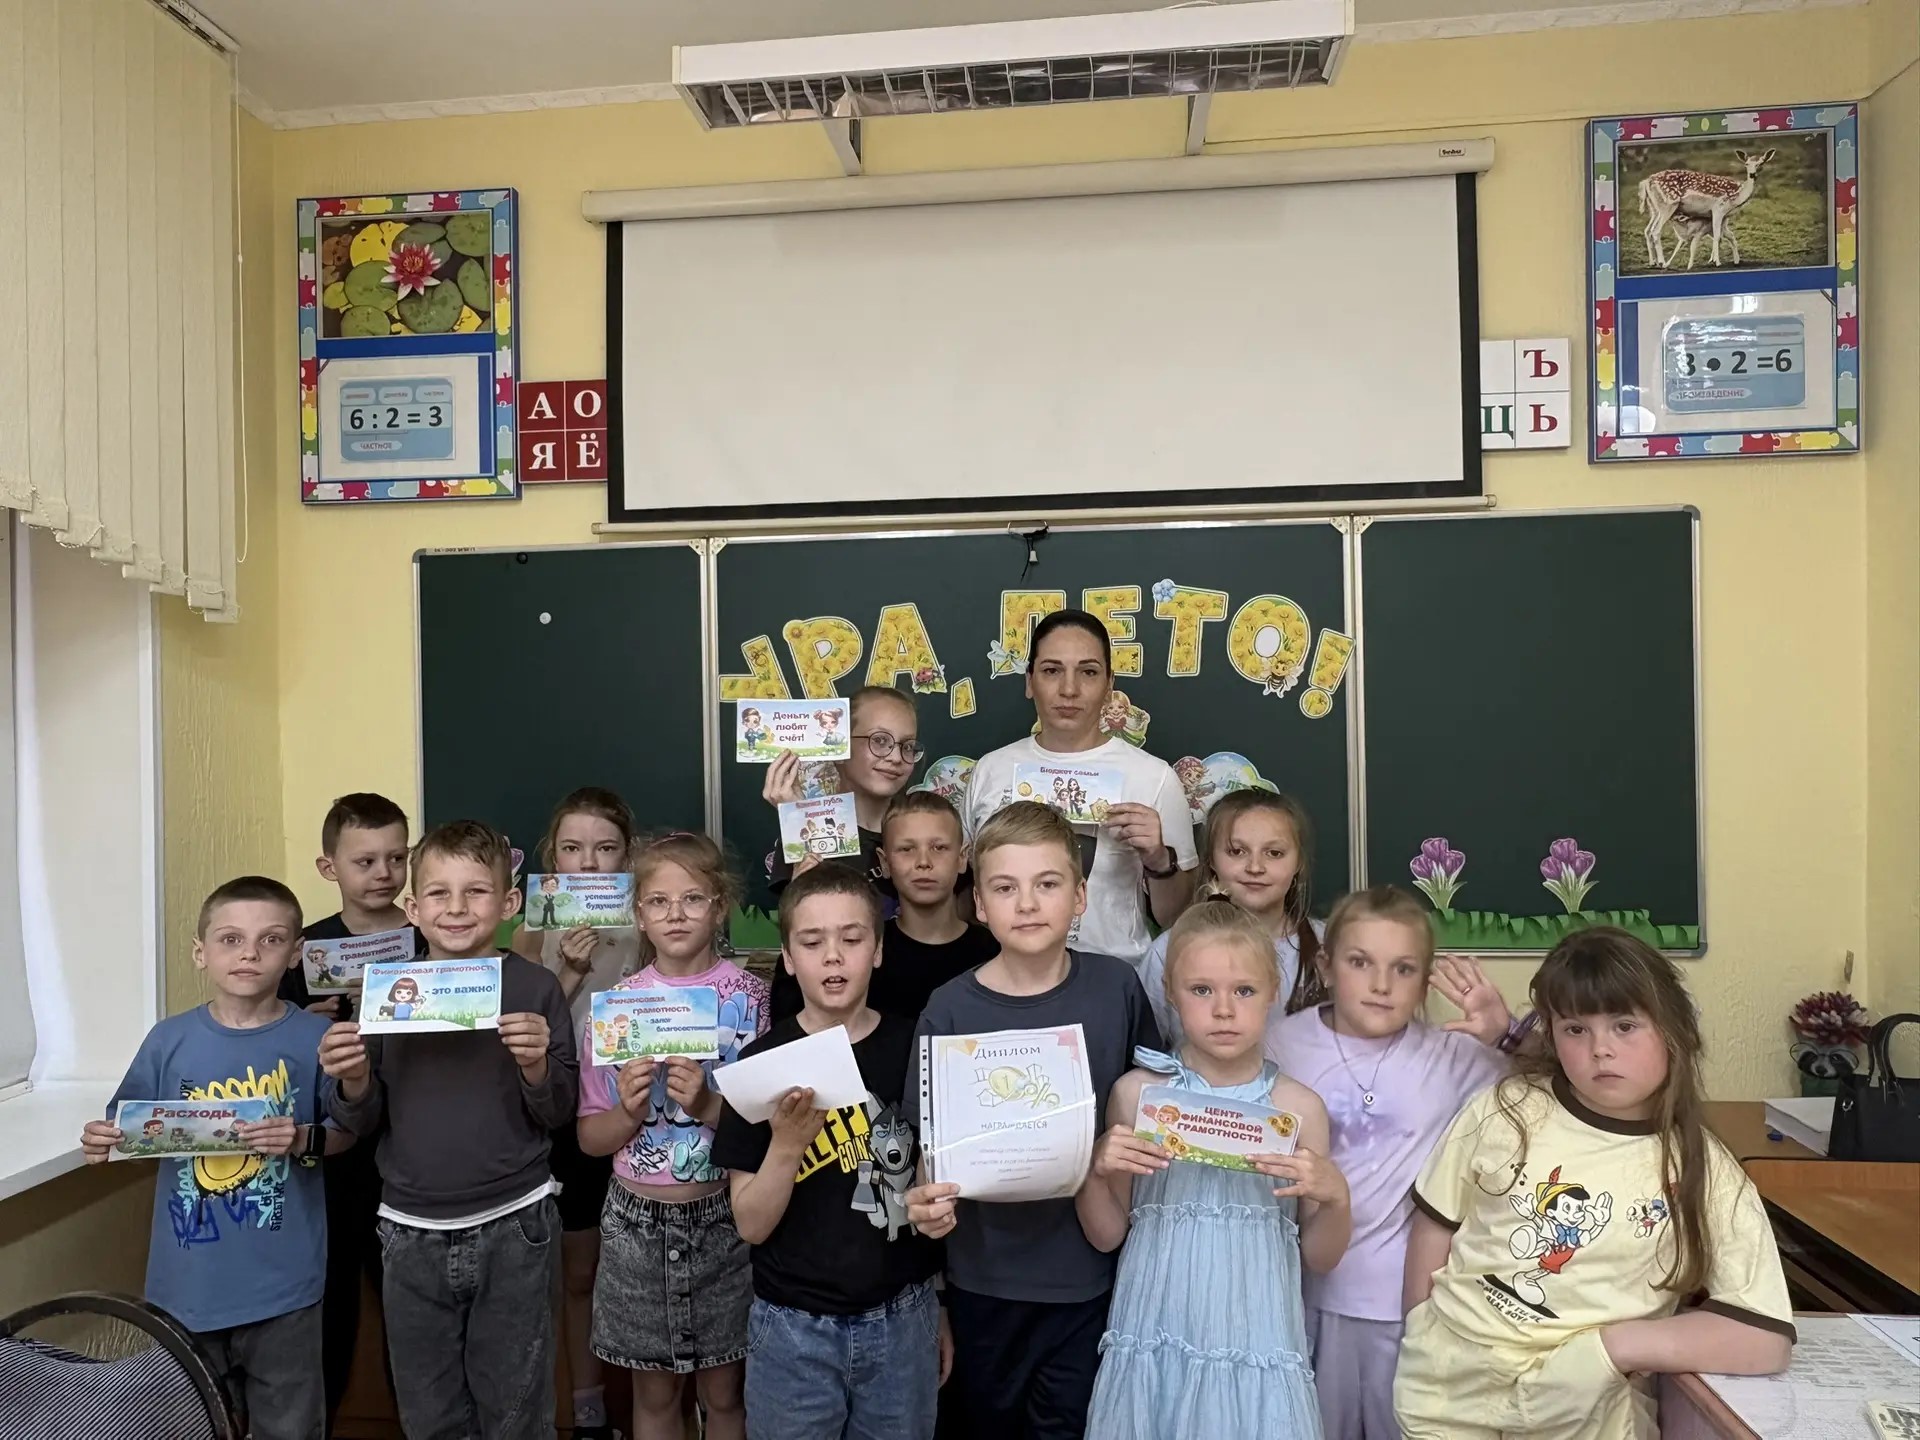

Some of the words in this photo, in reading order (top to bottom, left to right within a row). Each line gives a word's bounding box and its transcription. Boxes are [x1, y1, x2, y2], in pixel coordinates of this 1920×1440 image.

[1523, 349, 1559, 378] Ъ
[1731, 350, 1748, 374] 2
[527, 391, 557, 419] А
[573, 389, 602, 418] О
[350, 408, 364, 430] 6
[386, 407, 400, 429] 2
[428, 405, 443, 427] 3
[1528, 403, 1558, 433] Ь
[528, 441, 557, 470] Я
[576, 432, 601, 468] Ё
[772, 711, 810, 721] Деньги
[775, 722, 808, 731] любят
[779, 733, 805, 742] счёт!
[1040, 766, 1073, 776] Бюджет
[584, 893, 626, 901] успешное
[340, 945, 402, 962] грамотность
[372, 965, 434, 976] Финансовая
[435, 963, 496, 975] грамотность
[431, 986, 451, 996] это
[454, 983, 496, 995] важно!
[632, 1005, 692, 1016] грамотность
[152, 1107, 238, 1120] Расходы
[1204, 1106, 1244, 1120] ЦЕНТР
[1181, 1112, 1263, 1134] ФИНАНСОВОЙ
[1177, 1123, 1263, 1144] ГРАМОТНОСТИ
